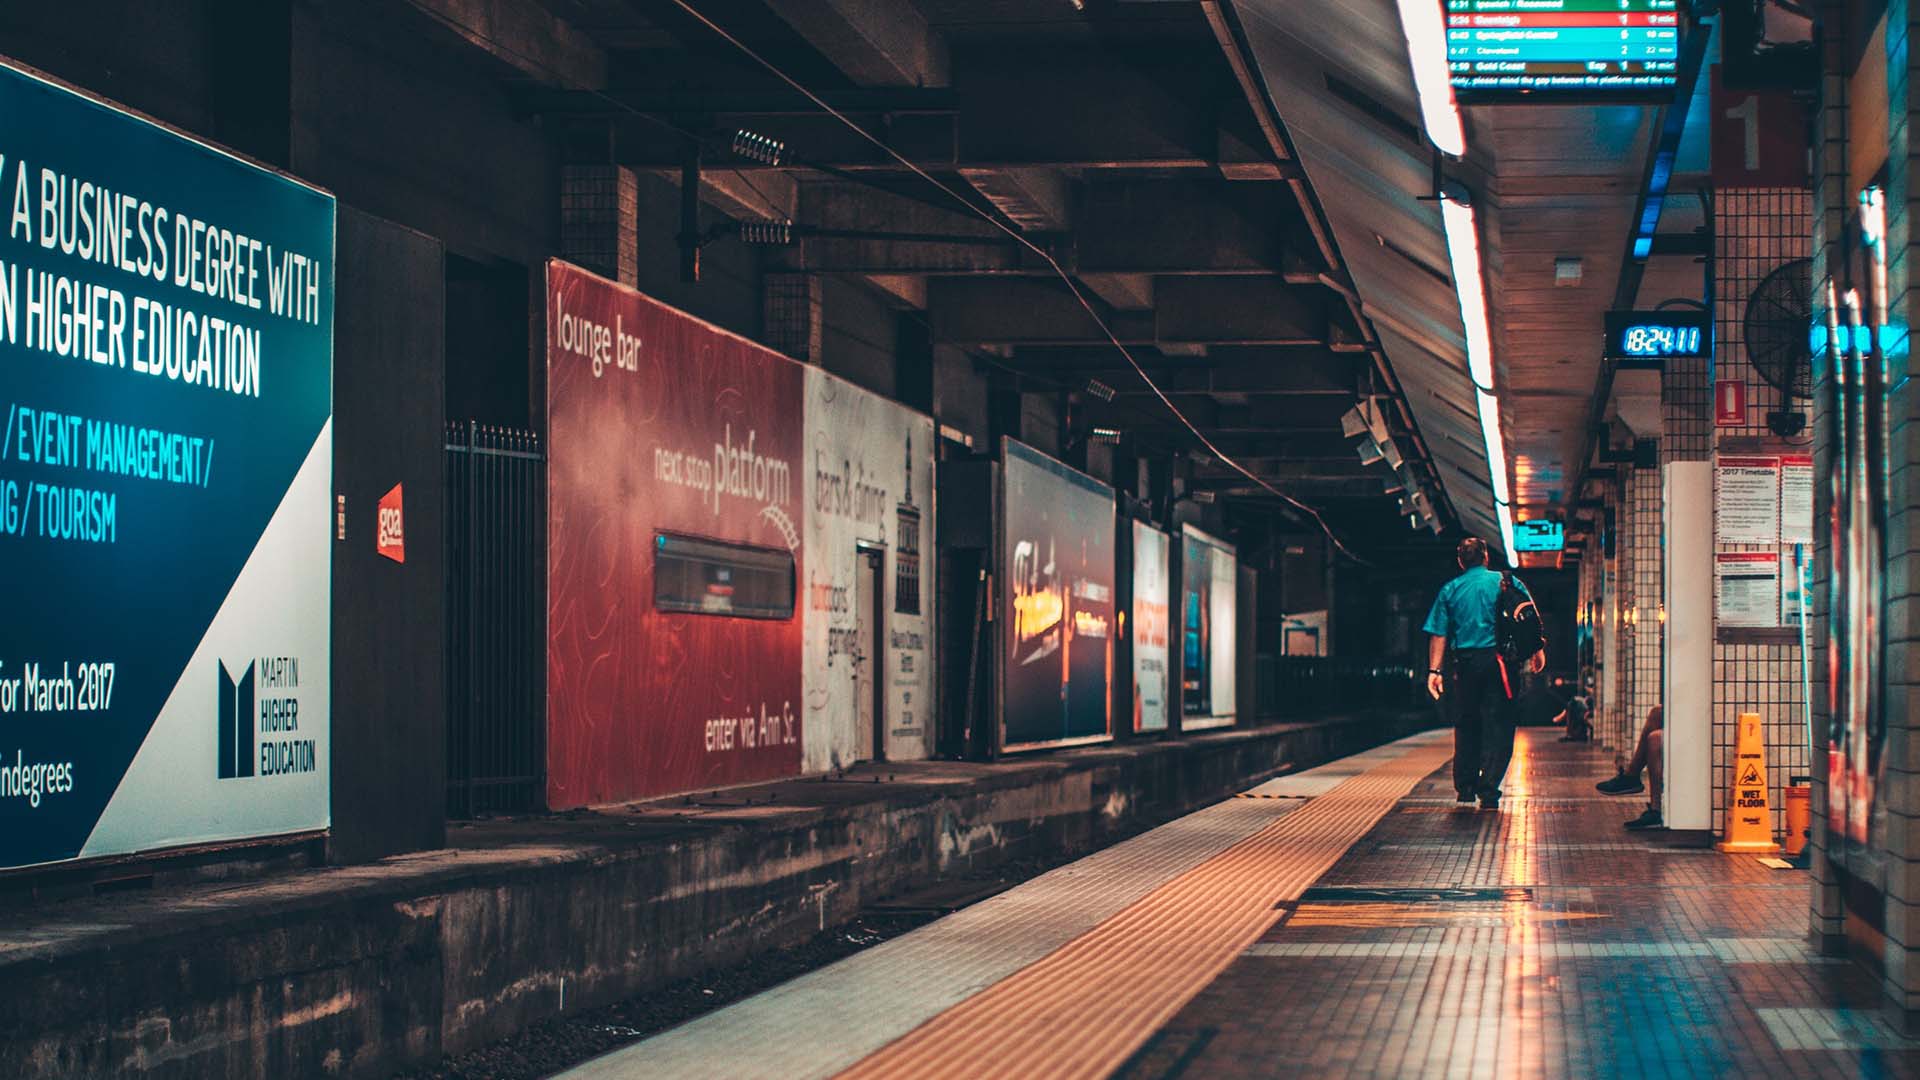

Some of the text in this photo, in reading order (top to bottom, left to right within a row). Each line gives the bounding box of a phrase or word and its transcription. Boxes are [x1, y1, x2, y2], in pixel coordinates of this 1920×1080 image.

[1475, 62, 1499, 71] Gold
[1499, 62, 1526, 71] Coast
[1725, 95, 1760, 170] 1
[11, 160, 320, 325] A BUSINESS DEGREE WITH
[26, 268, 126, 368] HIGHER
[133, 296, 260, 397] EDUCATION
[556, 291, 642, 378] lounge bar
[18, 407, 83, 468] EVENT
[86, 418, 204, 486] MANAGEMENT
[655, 423, 791, 516] next stop platform
[1721, 468, 1776, 477] 2017 Timetable
[35, 483, 117, 544] TOURISM
[24, 661, 75, 712] March
[77, 662, 115, 711] 2017
[260, 656, 300, 688] MARTIN
[260, 698, 299, 732] HIGHER
[705, 715, 738, 752] enter
[739, 705, 756, 748] via
[758, 701, 780, 747] Ann
[260, 739, 317, 777] EDUCATION
[1737, 799, 1766, 808] FLOOR
[1741, 790, 1761, 799] WET
